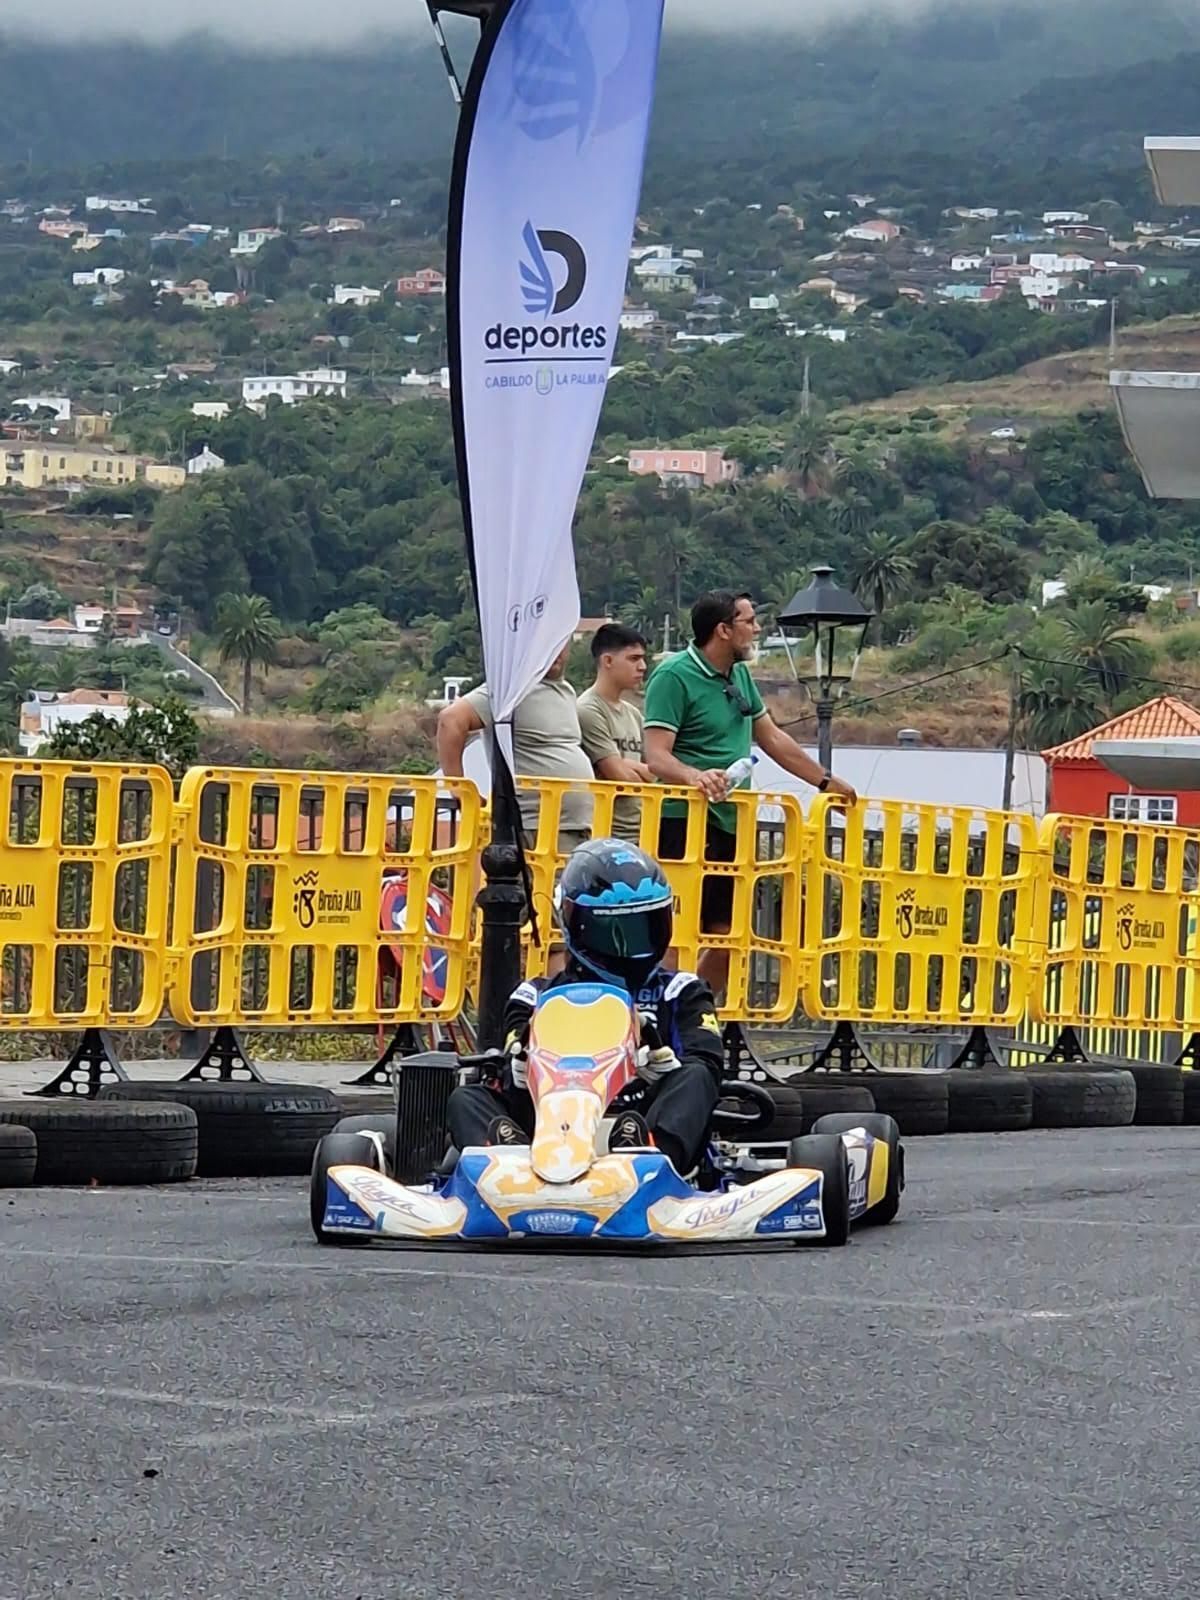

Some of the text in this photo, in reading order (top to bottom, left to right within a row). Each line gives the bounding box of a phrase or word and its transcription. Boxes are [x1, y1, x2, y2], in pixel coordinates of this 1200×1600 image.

[485, 323, 607, 355] deportes
[485, 373, 605, 388] CABILDO LA PALMA
[15, 884, 35, 907] ALTA
[318, 889, 361, 911] Breña ALTA
